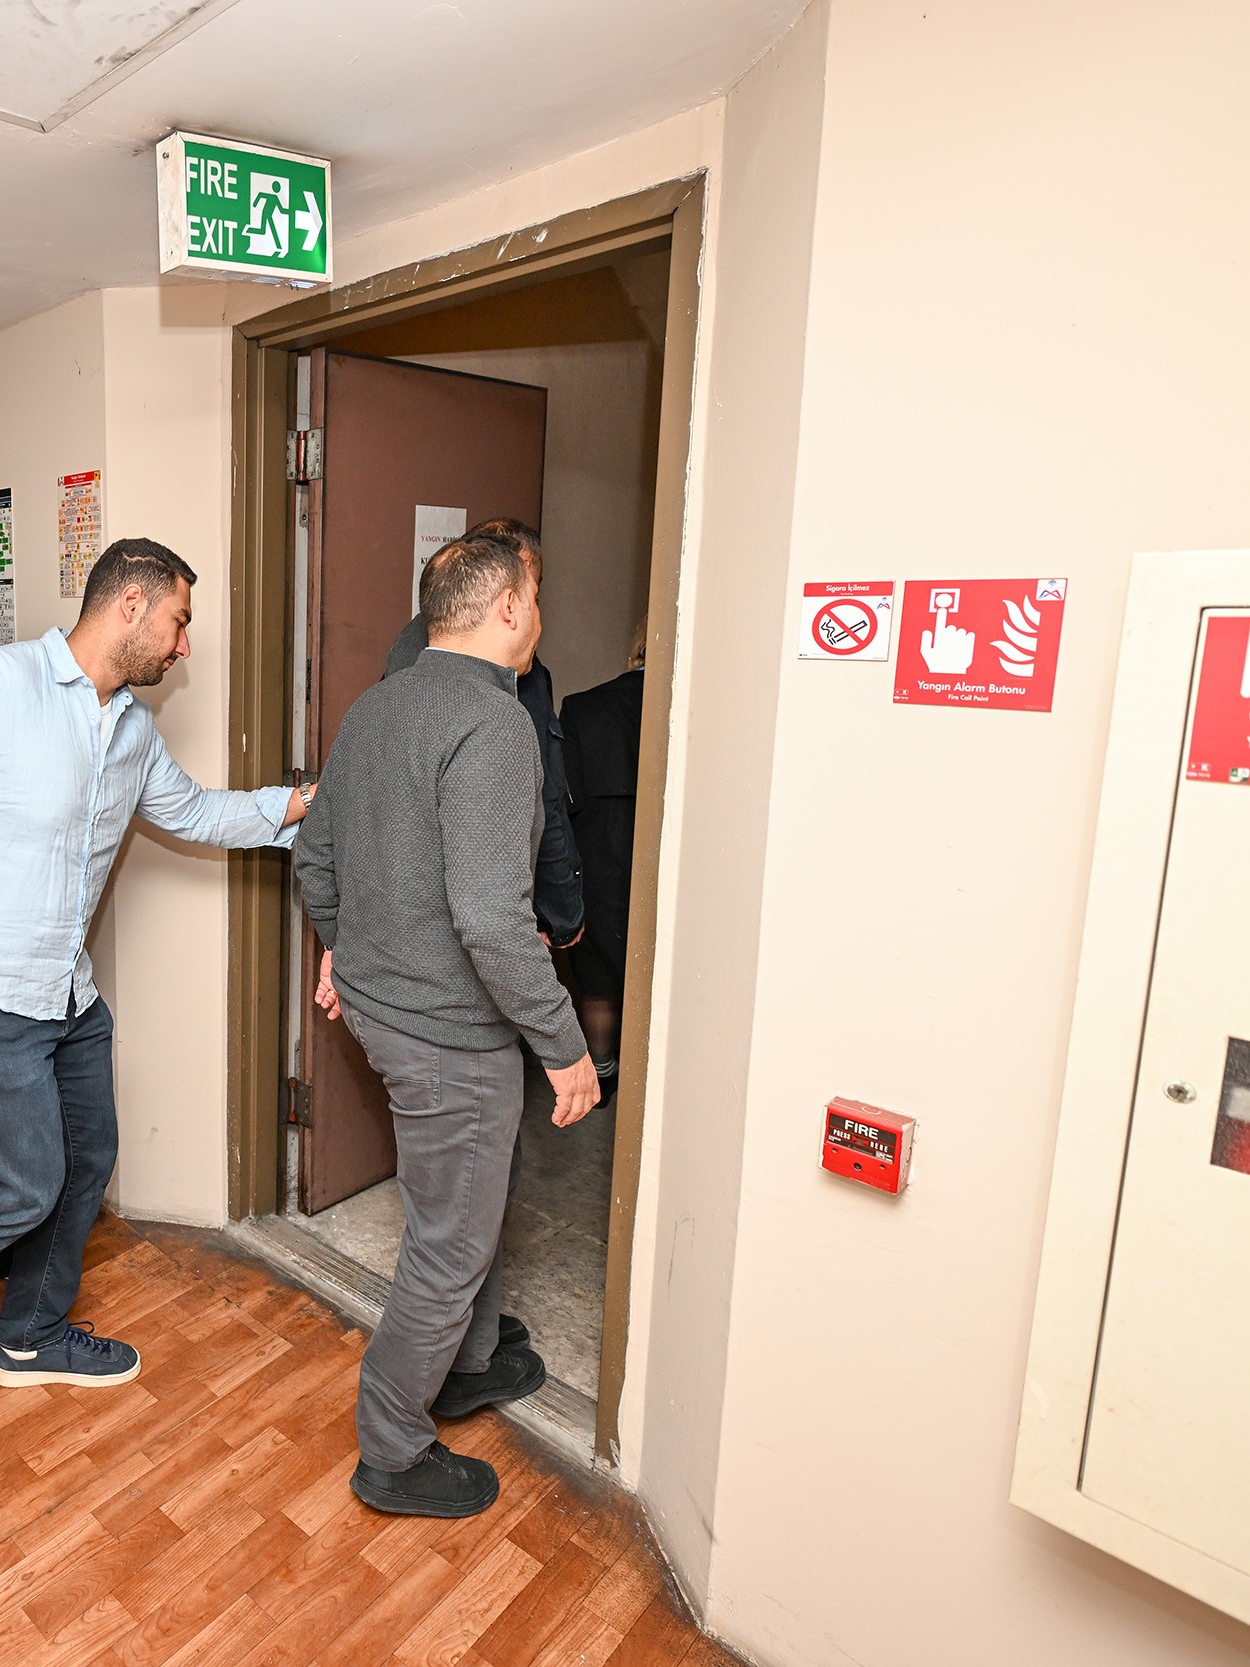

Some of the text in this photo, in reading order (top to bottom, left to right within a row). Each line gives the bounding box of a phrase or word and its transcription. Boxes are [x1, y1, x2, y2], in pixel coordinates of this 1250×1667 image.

[186, 156, 238, 200] FIRE
[187, 214, 238, 256] EXIT
[825, 584, 846, 593] Sigara
[917, 680, 1026, 695] Yangın Alarm Butonu
[844, 1119, 879, 1140] FIRE
